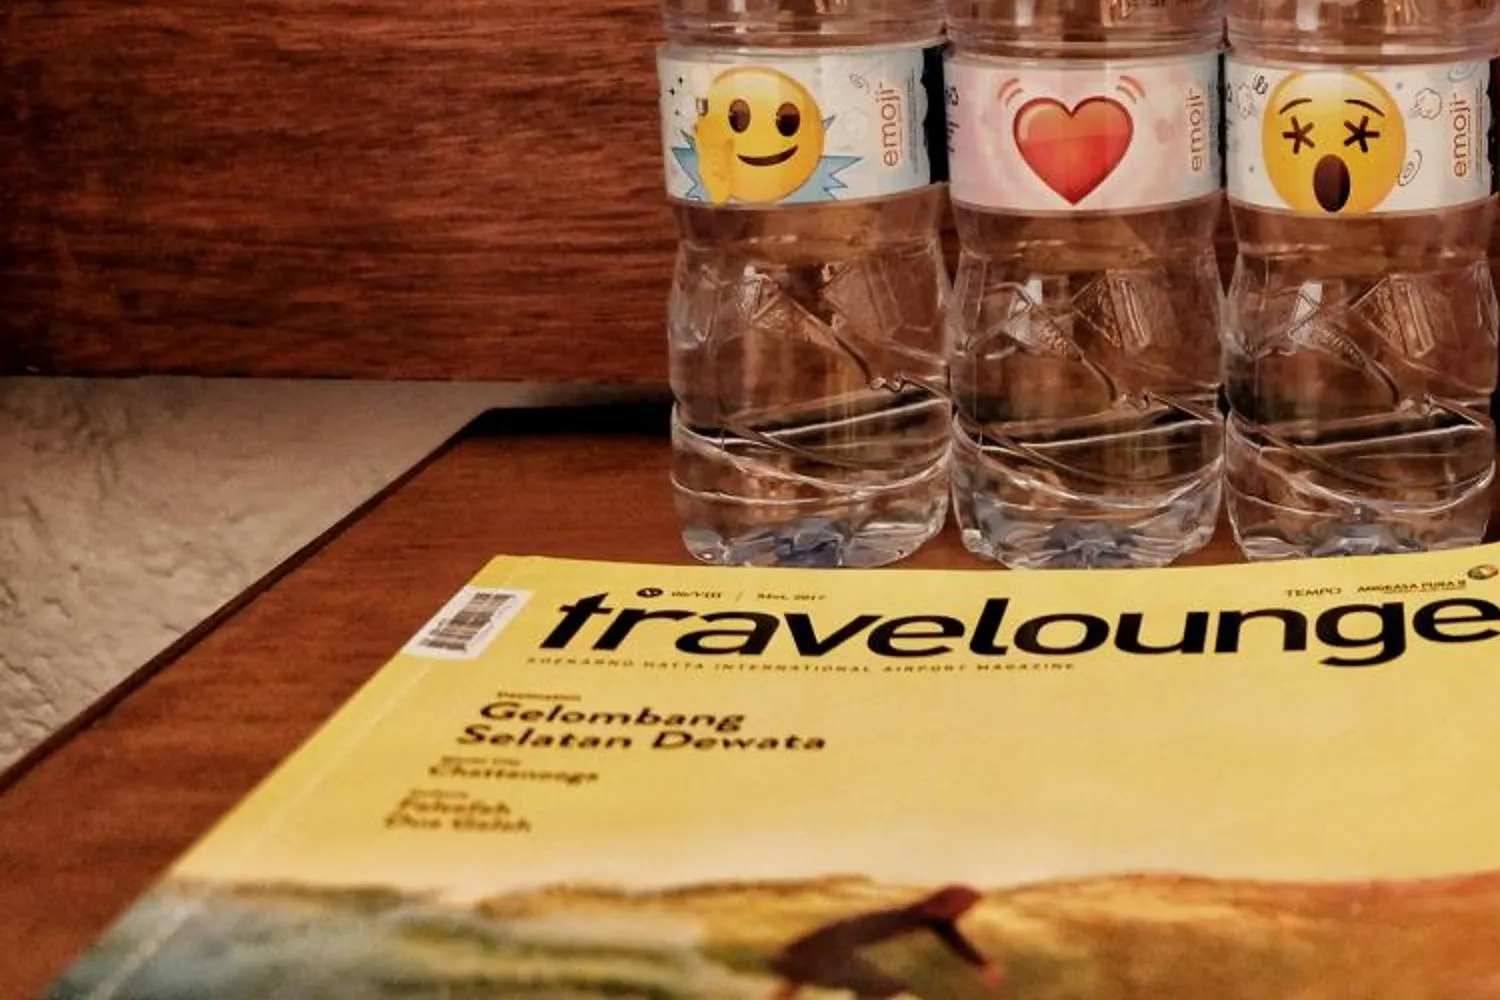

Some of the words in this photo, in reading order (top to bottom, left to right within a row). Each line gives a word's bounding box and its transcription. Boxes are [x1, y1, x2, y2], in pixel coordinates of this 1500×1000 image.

[876, 87, 901, 167] emoji
[1186, 93, 1205, 172] emoji
[1450, 98, 1471, 177] emoji
[1286, 587, 1342, 598] TEMPO
[456, 724, 633, 749] Selatan
[651, 730, 827, 750] Dewata
[479, 701, 746, 733] Gelombang
